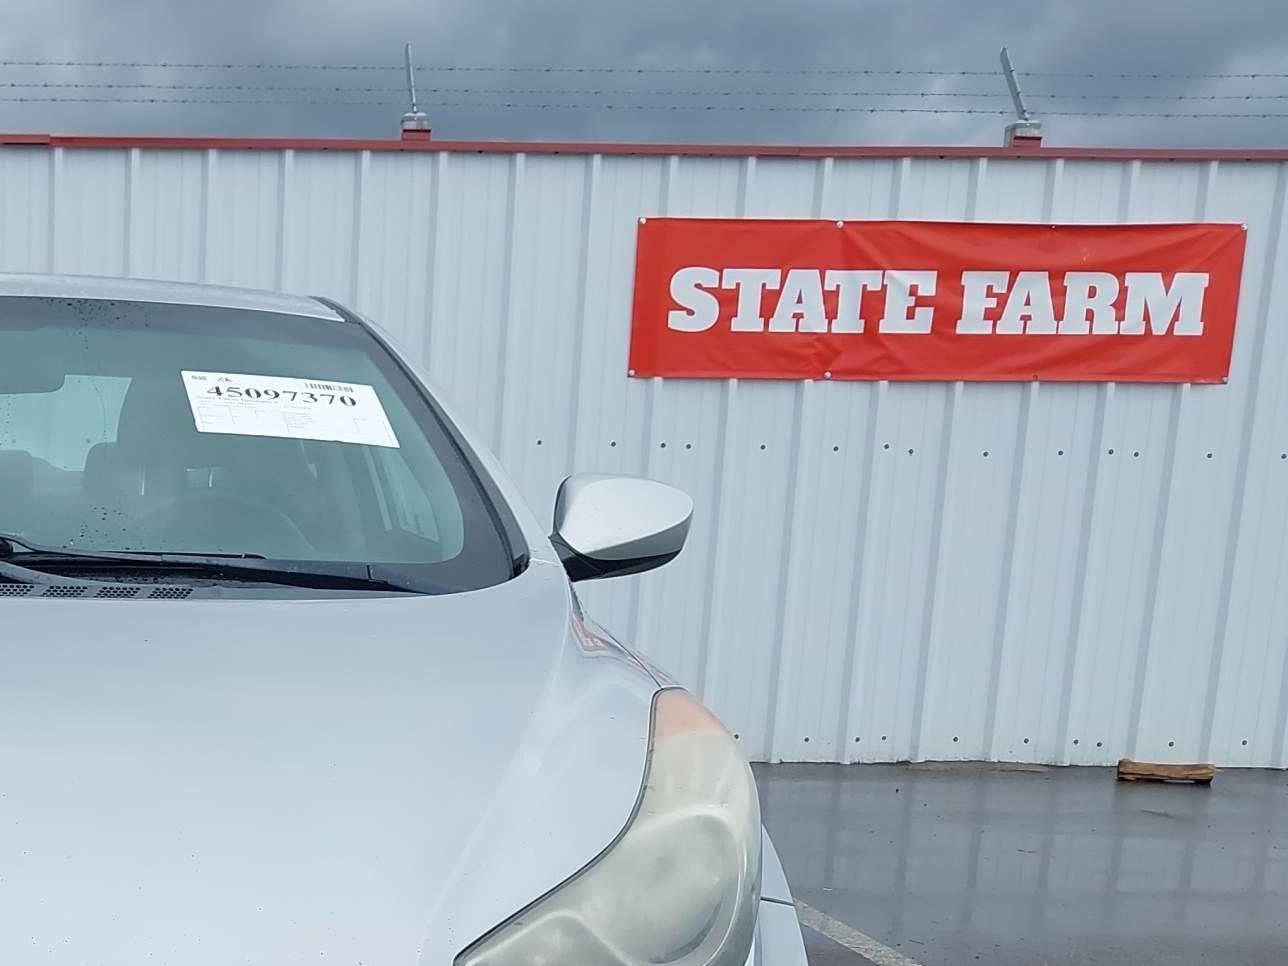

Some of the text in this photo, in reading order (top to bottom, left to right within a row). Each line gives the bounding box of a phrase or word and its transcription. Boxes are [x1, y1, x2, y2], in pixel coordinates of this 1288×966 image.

[667, 267, 1210, 337] STATE FARM
[206, 385, 358, 407] 45097370
